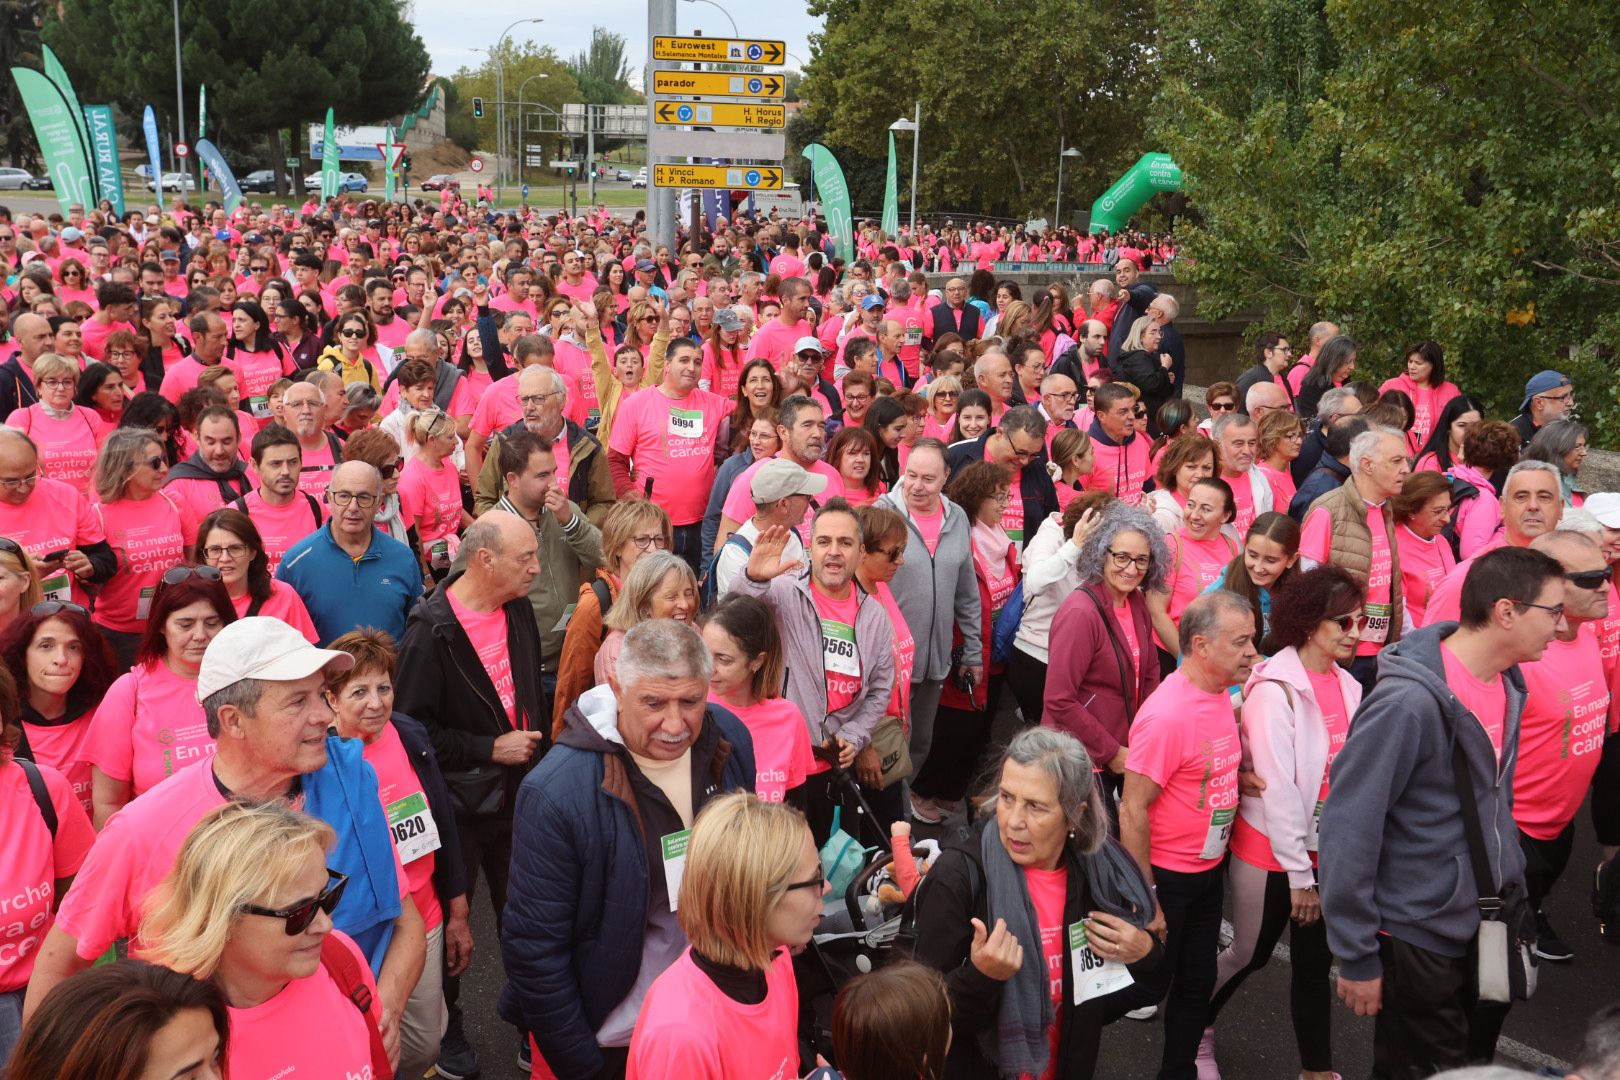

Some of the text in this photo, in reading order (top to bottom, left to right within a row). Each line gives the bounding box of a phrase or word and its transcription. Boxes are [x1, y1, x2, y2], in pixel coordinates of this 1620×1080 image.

[655, 40, 716, 50] H. Eurowest
[657, 79, 696, 88] parador
[743, 107, 782, 116] H. Horus
[745, 116, 782, 126] H. Regio
[656, 168, 695, 176] H. Vincci
[1149, 169, 1172, 178] contra
[668, 176, 677, 184] P.
[680, 177, 715, 186] Romano
[671, 416, 694, 429] 6994
[45, 450, 59, 459] En
[670, 445, 711, 458] cáncer
[127, 539, 144, 549] En
[129, 545, 176, 562] contra
[1200, 572, 1215, 582] En
[827, 678, 862, 695] ncer
[1573, 704, 1588, 719] En
[175, 745, 201, 760] En
[1214, 757, 1227, 771] En
[755, 767, 786, 783] rcha
[0, 881, 52, 915] rcha
[30, 901, 51, 930] el
